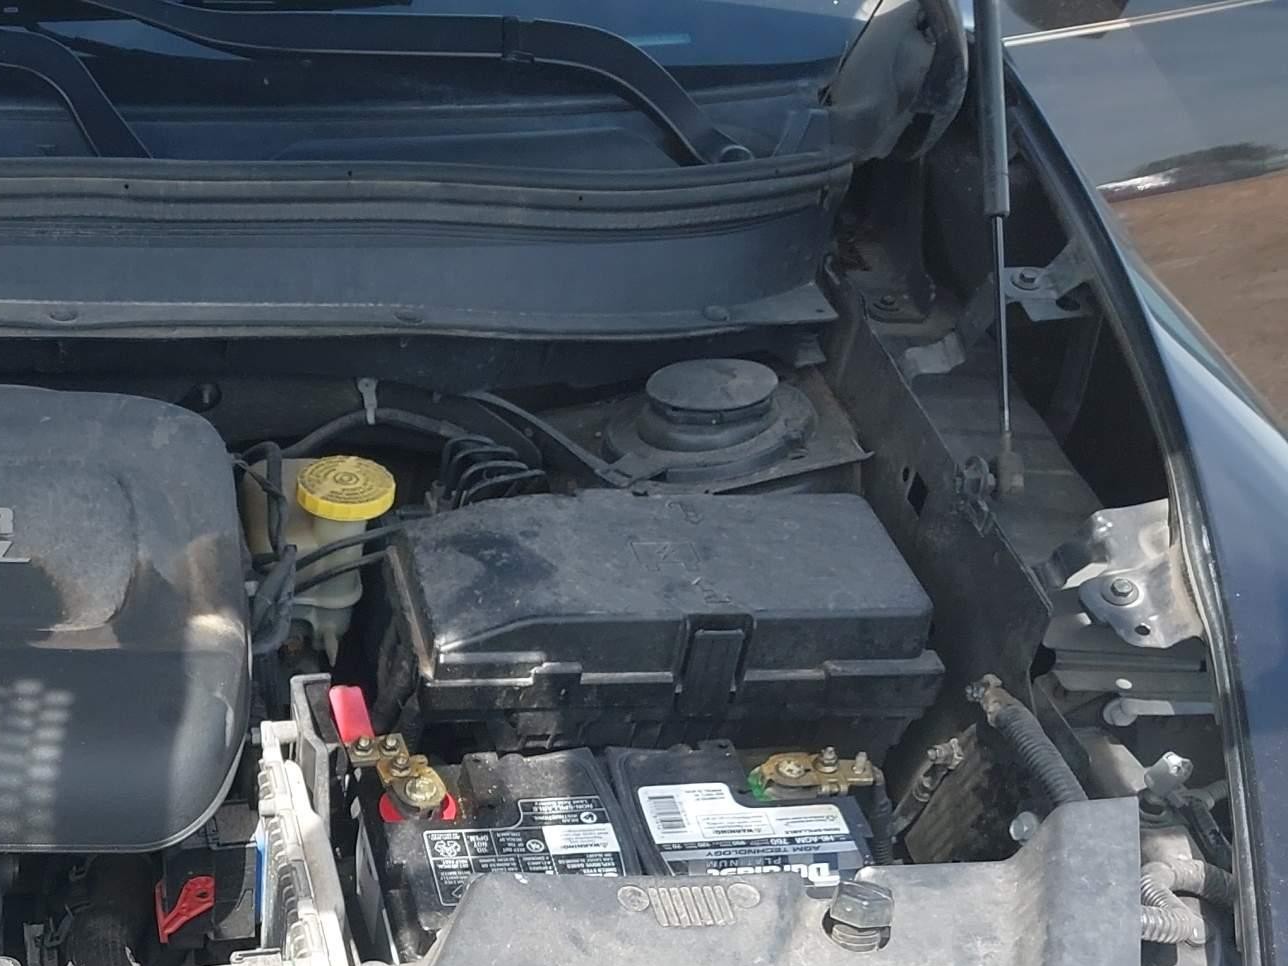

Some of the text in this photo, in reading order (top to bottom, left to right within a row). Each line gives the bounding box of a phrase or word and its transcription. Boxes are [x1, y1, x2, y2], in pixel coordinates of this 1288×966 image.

[705, 845, 820, 857] AGM TECHNOLOGY
[705, 857, 782, 868] PLATINUM
